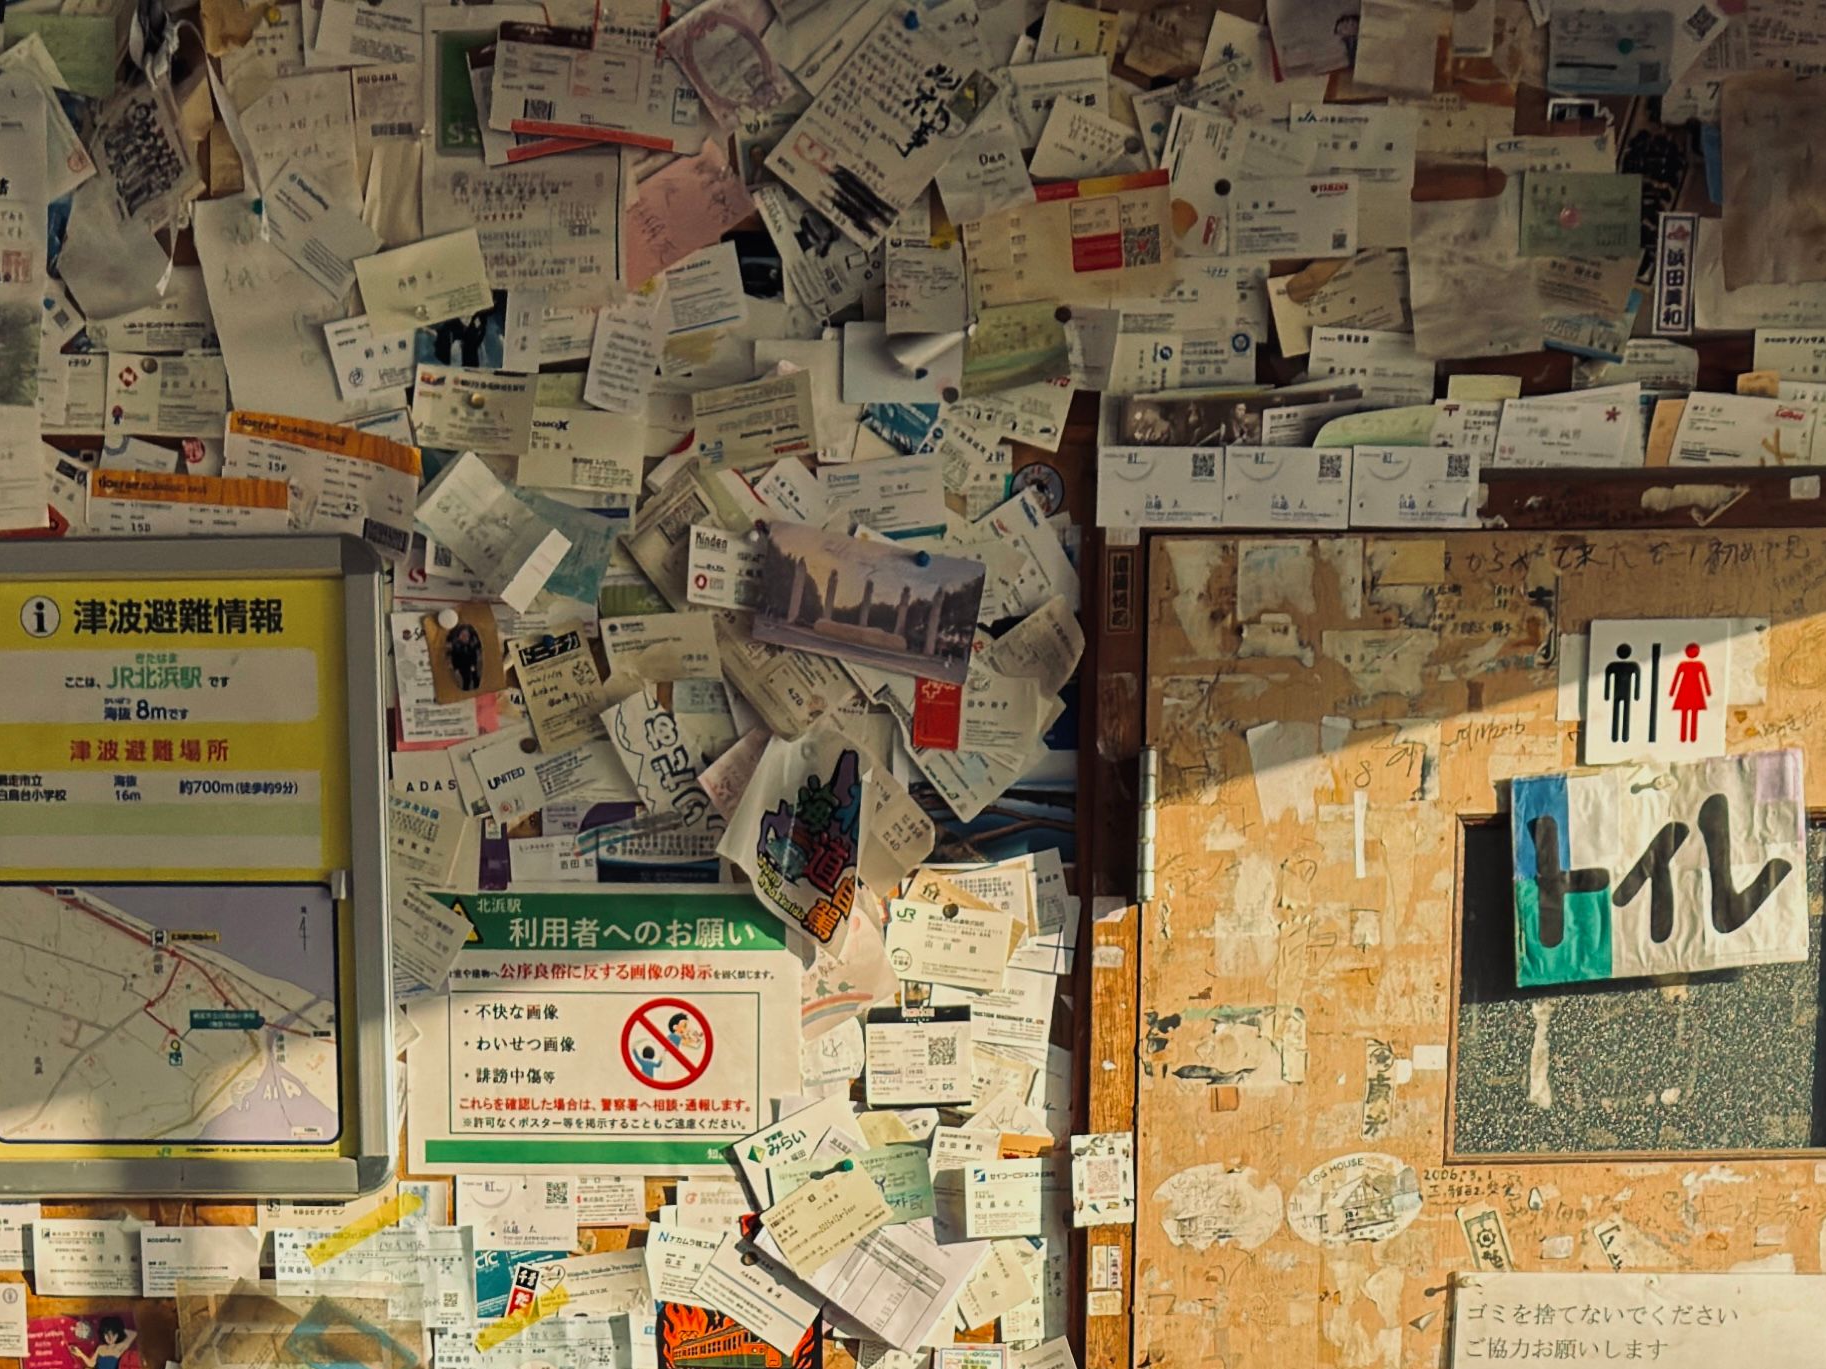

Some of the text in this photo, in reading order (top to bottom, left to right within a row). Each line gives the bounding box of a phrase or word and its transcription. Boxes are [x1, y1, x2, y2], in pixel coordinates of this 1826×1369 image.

[696, 531, 728, 550] Kinden
[73, 598, 284, 636] 津波避難情報
[107, 666, 202, 691] JR北浜駅
[208, 675, 230, 688] です
[103, 706, 131, 721] 海抜
[69, 739, 230, 763] 津波避難場所
[113, 775, 138, 788] 海抜
[406, 779, 457, 793] ADAS
[488, 767, 526, 790] UNITED
[114, 789, 142, 802] 16m
[476, 898, 523, 913] 北浜駅
[896, 907, 916, 919] JR
[509, 916, 755, 949] 利用者へのお願い
[476, 1004, 560, 1021] 不快な画像
[476, 1035, 577, 1052] わいせつ画像
[459, 1098, 753, 1113] これらを確認した場合は、警察署へ相談・通報します。
[766, 1131, 807, 1155] みらい
[1330, 1157, 1365, 1177] HOUSE
[1466, 1302, 1740, 1328] ゴミを捨てないでください
[1464, 1338, 1669, 1361] ご協力お願いします
